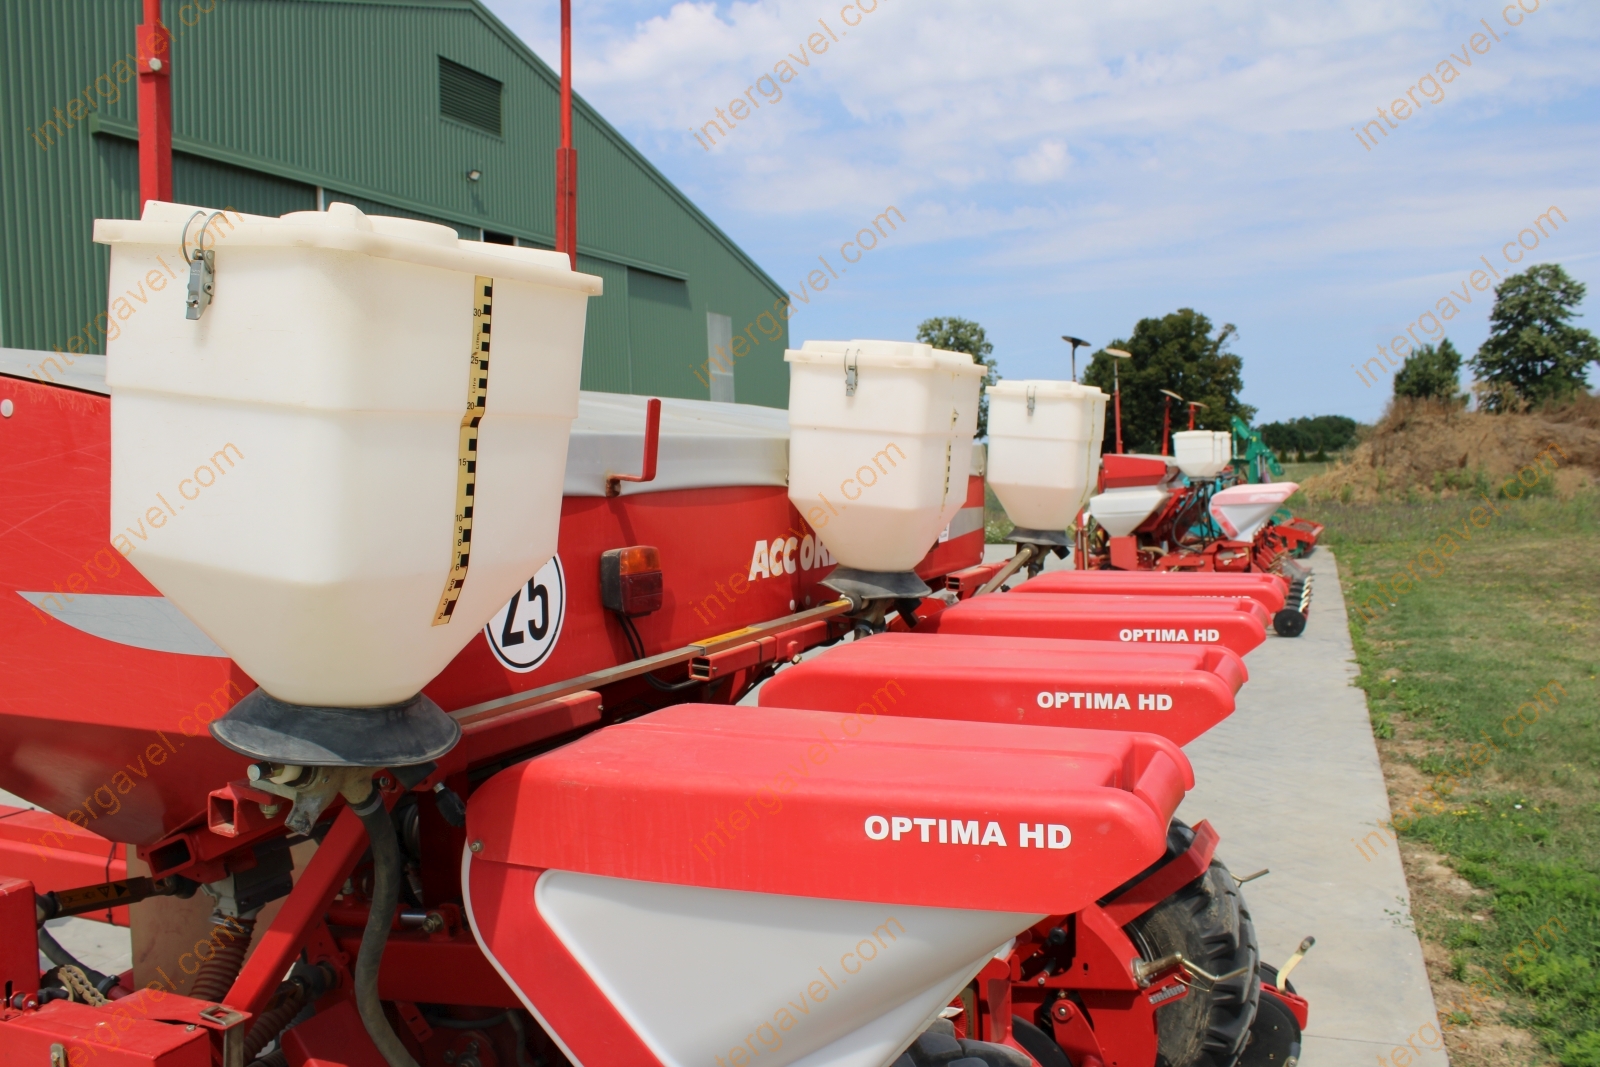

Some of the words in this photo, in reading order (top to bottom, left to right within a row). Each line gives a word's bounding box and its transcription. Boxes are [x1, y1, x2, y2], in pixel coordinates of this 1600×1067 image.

[473, 308, 482, 317] 30
[470, 355, 479, 365] 25
[466, 401, 475, 410] 20
[459, 458, 467, 466] 15
[456, 514, 463, 522] 10
[458, 525, 463, 534] 9
[457, 538, 462, 546] 8
[457, 551, 461, 559] 7
[748, 533, 838, 582] ACCOR
[455, 563, 460, 571] 6
[437, 612, 444, 620] 2
[501, 575, 549, 648] 25
[1119, 628, 1189, 642] OPTIMA
[1194, 628, 1220, 642] HD
[1036, 691, 1131, 710] OPTIMA
[1138, 693, 1173, 711] HD
[864, 815, 1007, 847] OPTIMA
[1019, 823, 1072, 849] HD
